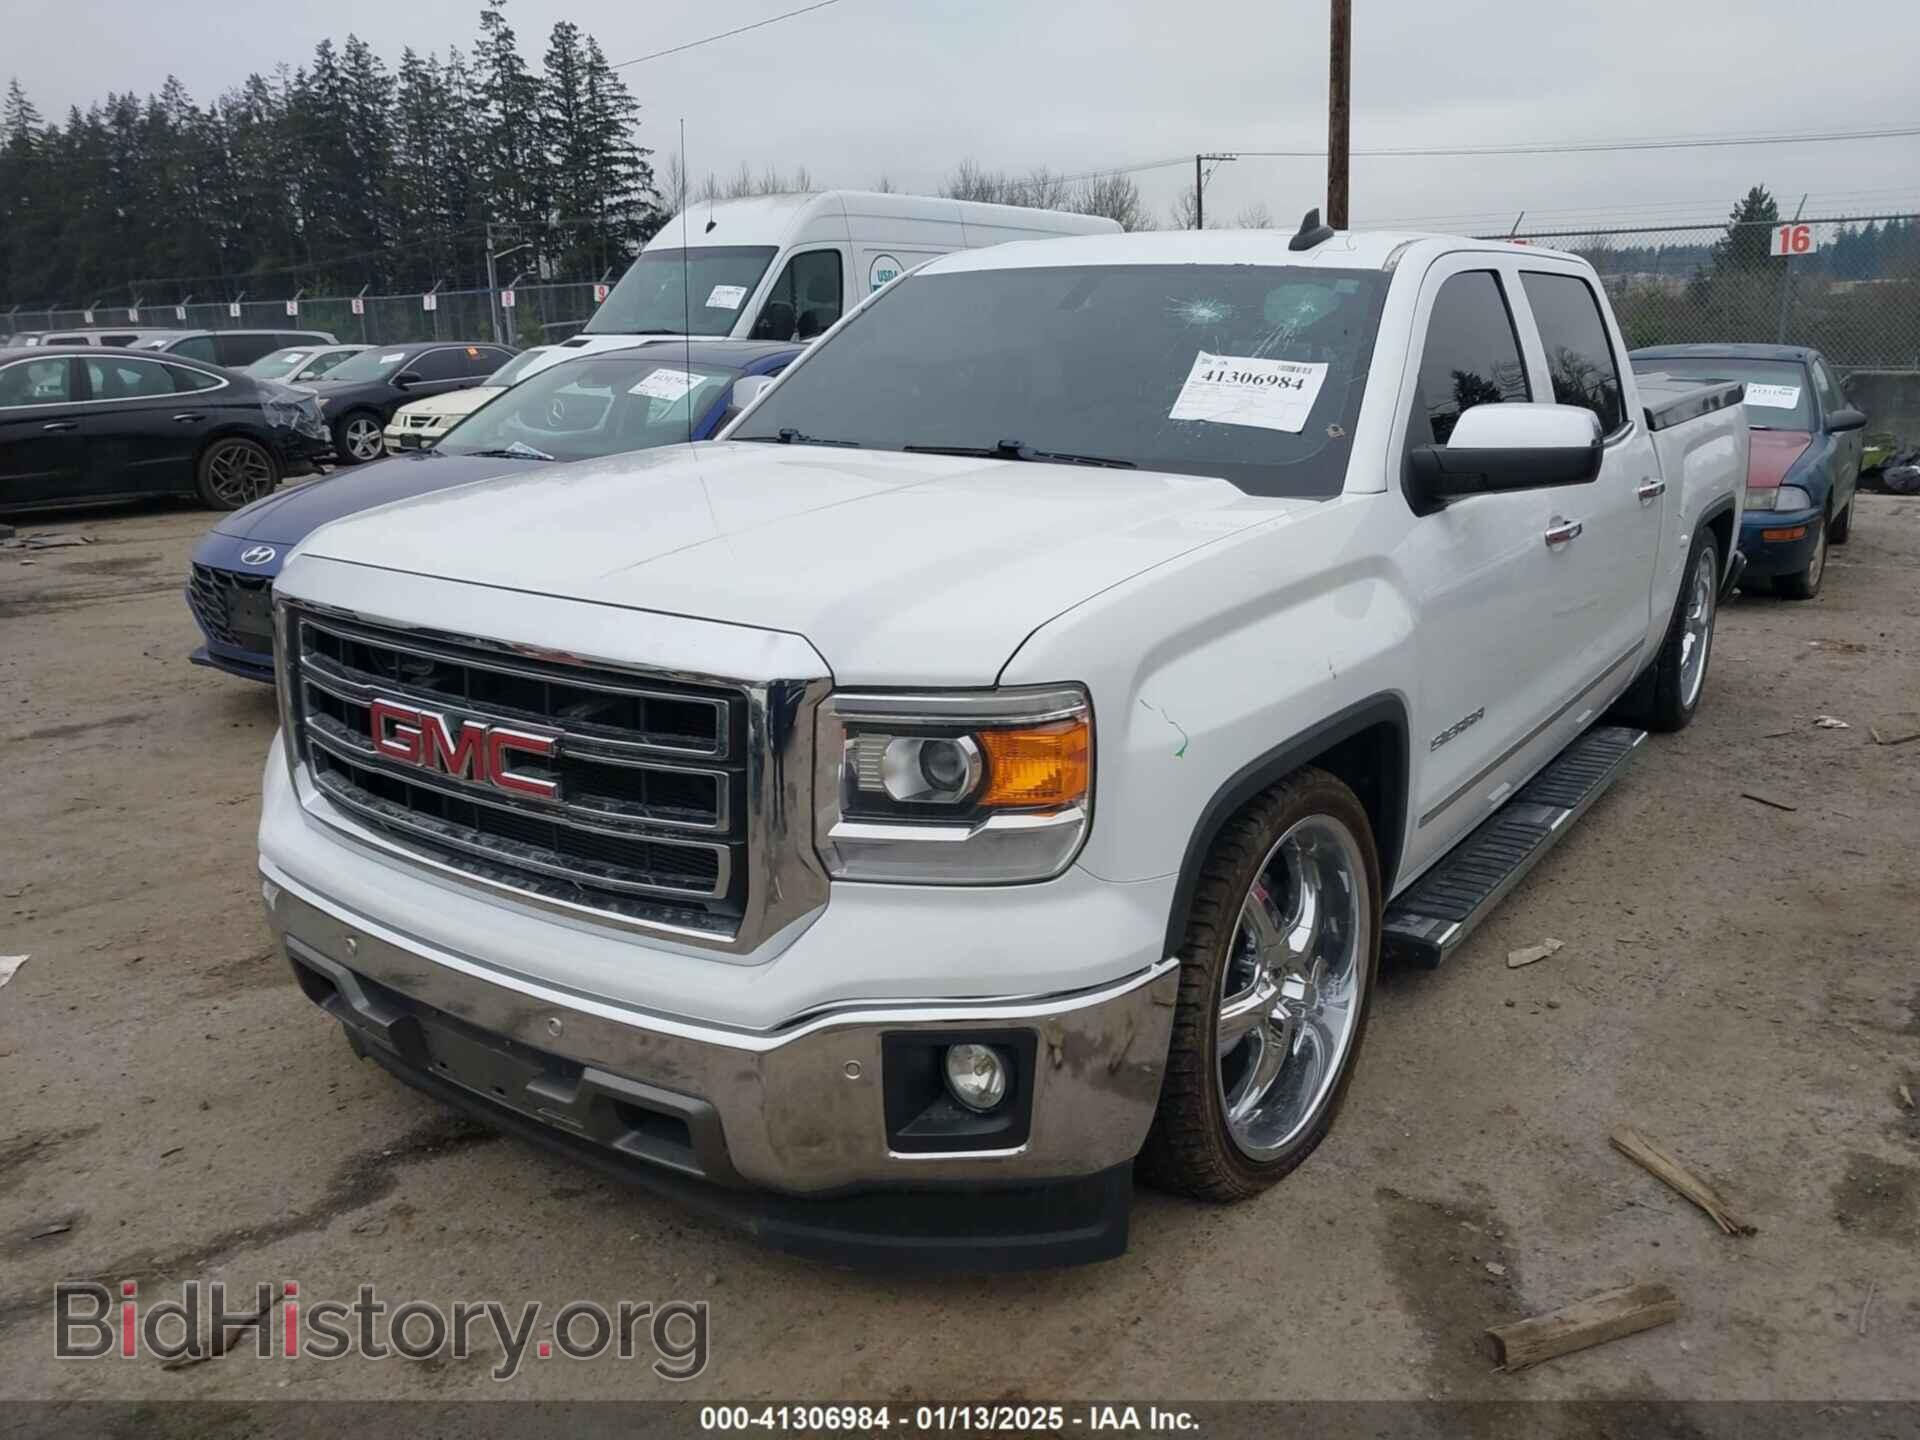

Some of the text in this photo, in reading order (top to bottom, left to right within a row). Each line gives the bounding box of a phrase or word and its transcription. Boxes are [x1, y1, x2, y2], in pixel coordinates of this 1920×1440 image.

[1780, 225, 1809, 253] 16
[1201, 369, 1305, 391] 41306984
[370, 697, 562, 801] GMC
